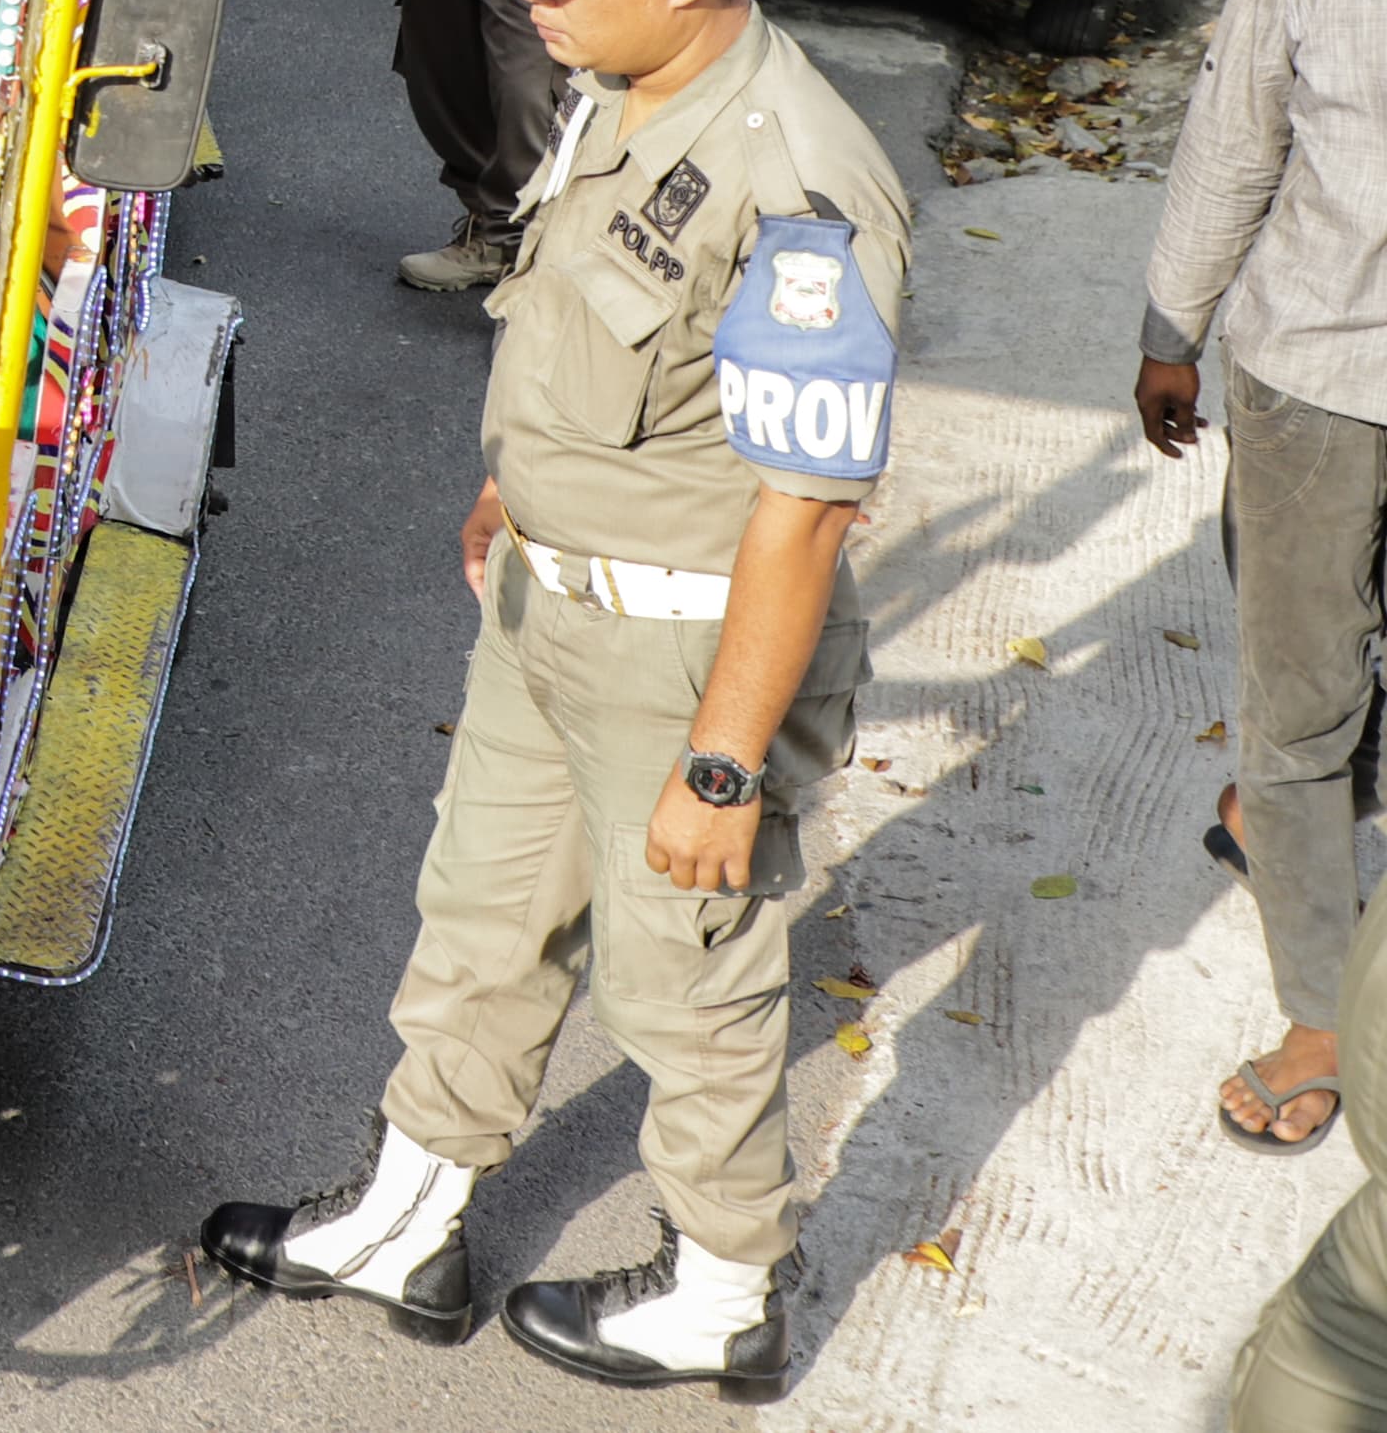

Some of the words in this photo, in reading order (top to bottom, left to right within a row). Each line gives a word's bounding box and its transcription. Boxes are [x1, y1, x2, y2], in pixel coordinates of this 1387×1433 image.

[608, 210, 649, 263] POL
[649, 246, 684, 282] PP
[720, 358, 888, 461] PROV
